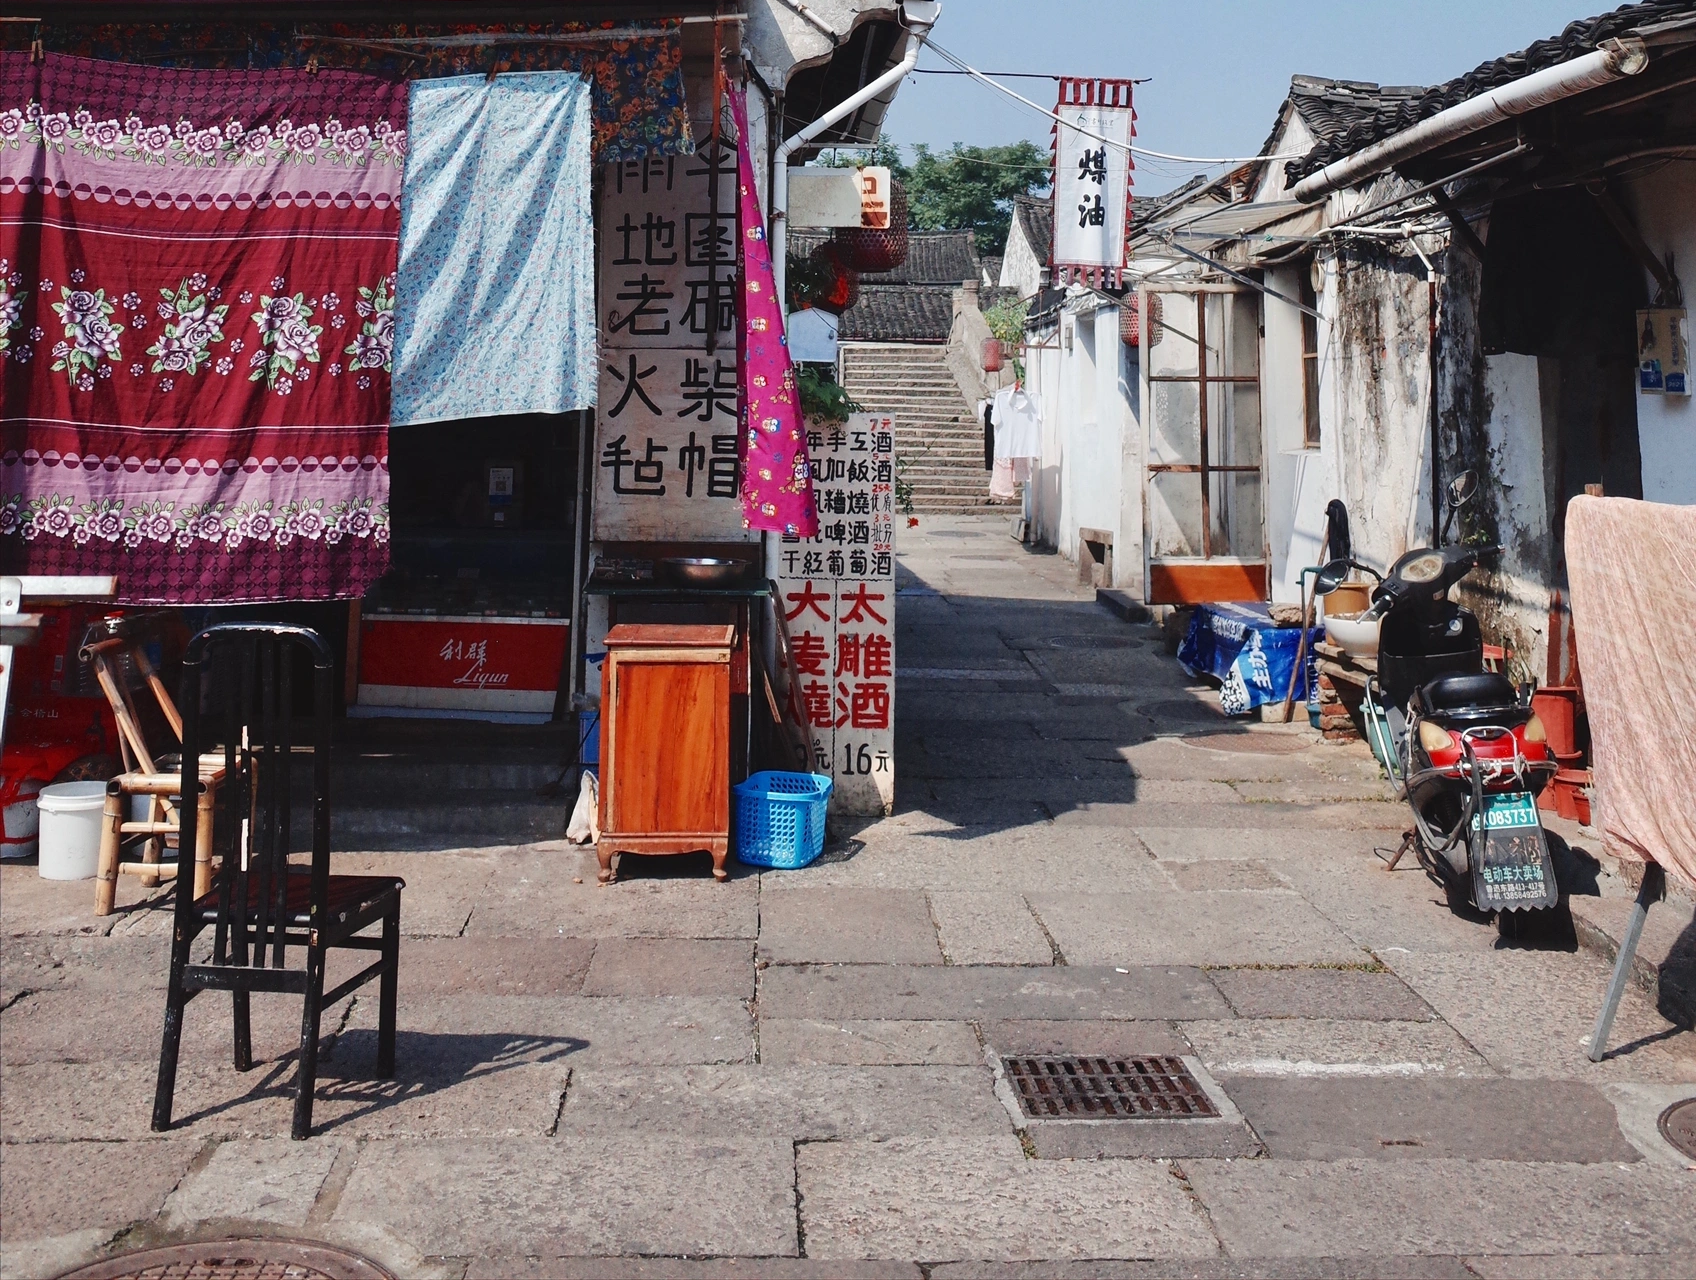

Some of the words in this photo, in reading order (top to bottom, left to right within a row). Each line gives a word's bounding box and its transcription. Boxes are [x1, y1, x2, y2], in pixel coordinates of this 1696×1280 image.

[1077, 145, 1107, 228] 煤油
[605, 353, 738, 422] 火柴
[869, 418, 891, 431] 7元
[600, 431, 738, 498] 毡帽
[872, 483, 892, 493] 25元
[875, 513, 891, 522] 3元
[439, 638, 488, 666] 利群
[453, 661, 510, 689] Liqun
[842, 743, 889, 775] 16元
[1483, 865, 1544, 883] 电动车大卖场
